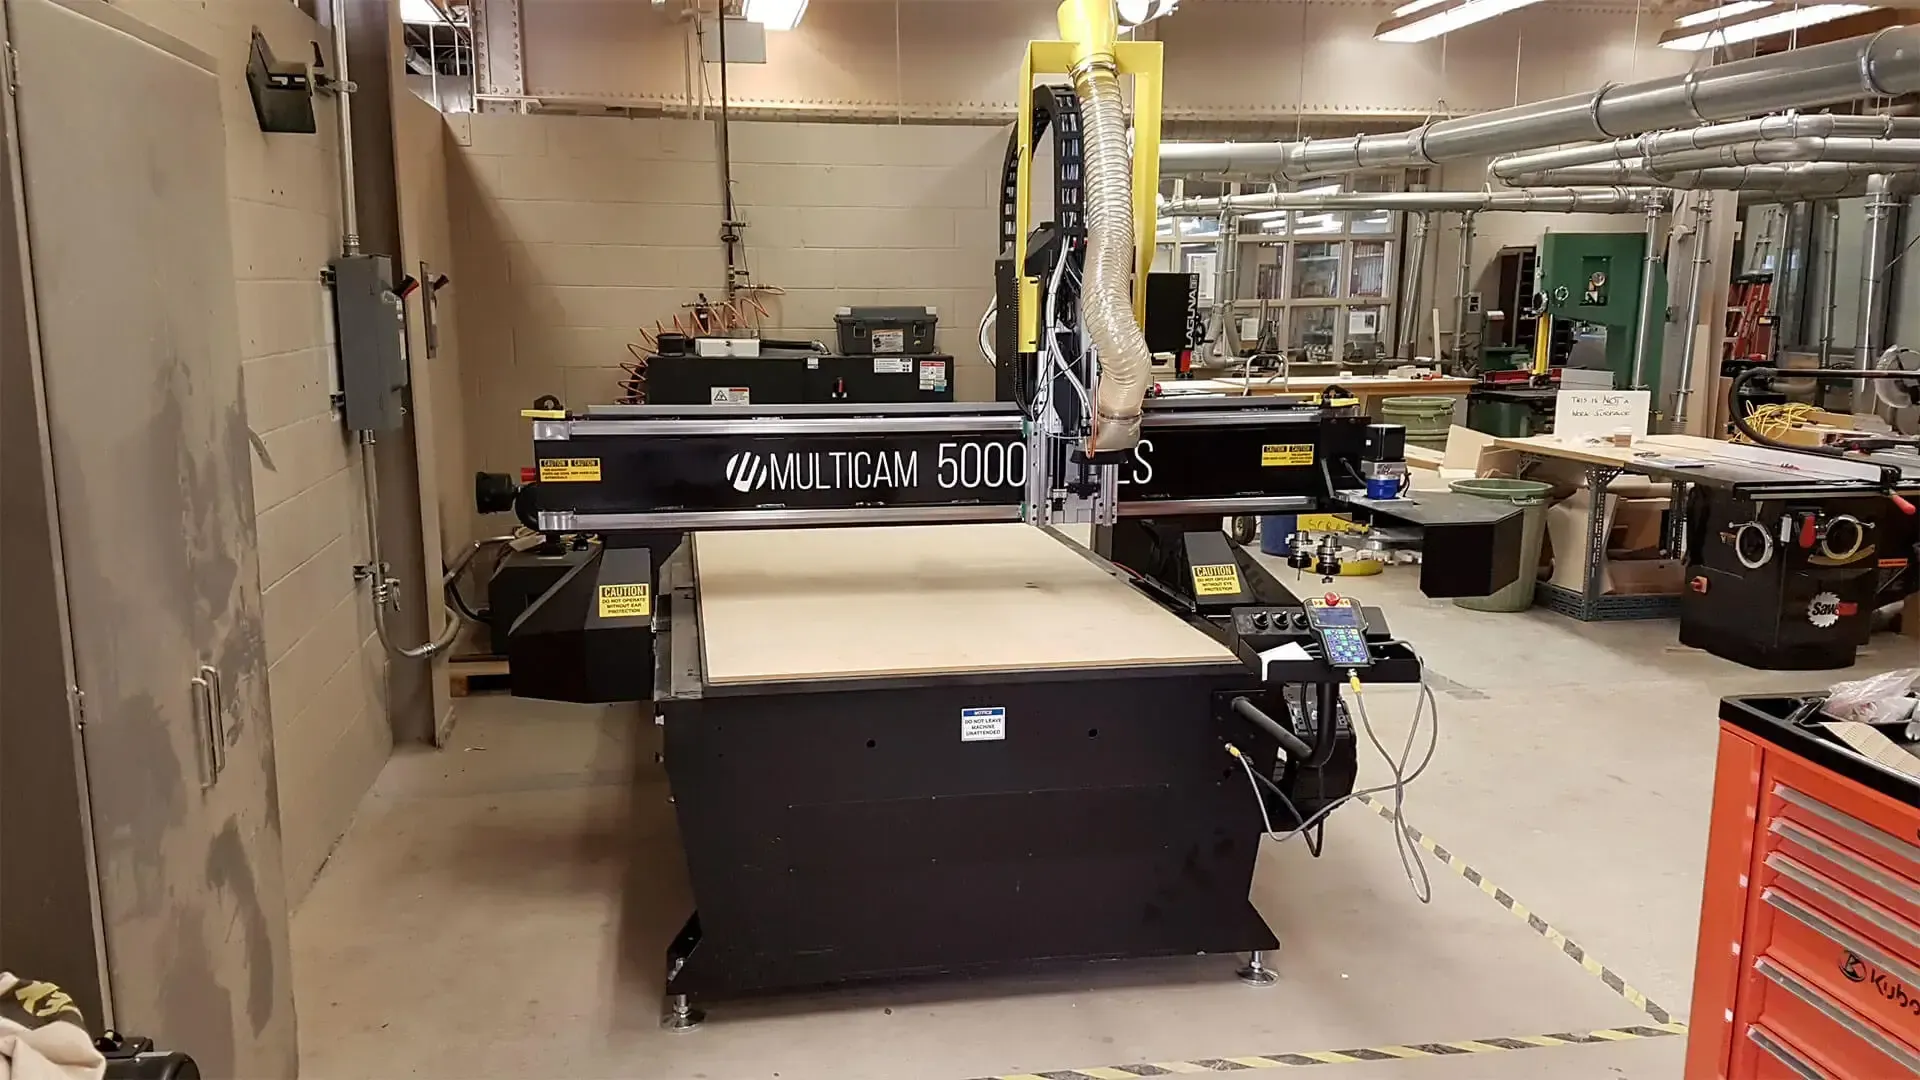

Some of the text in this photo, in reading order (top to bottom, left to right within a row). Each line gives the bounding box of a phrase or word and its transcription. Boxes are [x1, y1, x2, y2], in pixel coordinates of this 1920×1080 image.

[1185, 288, 1197, 349] LAGUNA
[1571, 396, 1587, 404] THIS
[1603, 395, 1624, 406] NOT
[1594, 409, 1631, 417] SURFACE
[769, 442, 1027, 490] MULTICAM 5000
[1197, 566, 1232, 576] CAUTION
[604, 586, 643, 597] CAUTION
